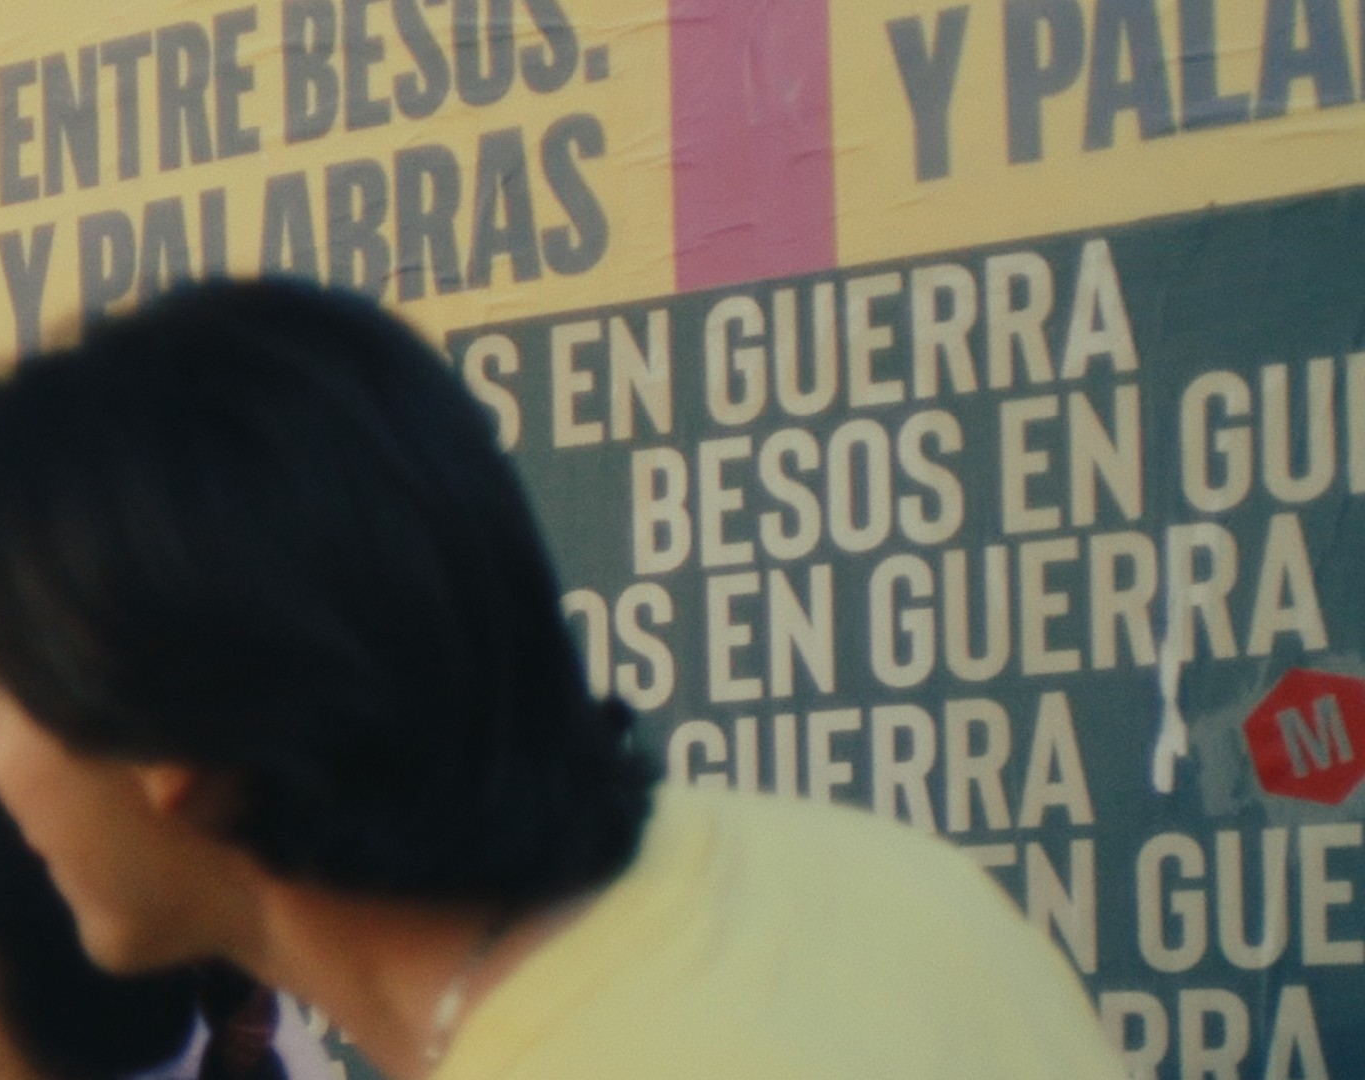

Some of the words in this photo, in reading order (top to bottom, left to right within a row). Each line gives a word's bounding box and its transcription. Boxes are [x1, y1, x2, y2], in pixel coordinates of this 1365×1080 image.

[886, 4, 968, 182] Y
[1003, 0, 1365, 165] PALA
[551, 308, 673, 449] EN
[705, 239, 1139, 426] GUERRA
[632, 409, 964, 576] BESOS
[1000, 383, 1143, 535] EN
[707, 563, 836, 702] EN
[870, 513, 1328, 689] GUERRA
[1275, 693, 1356, 780] M
